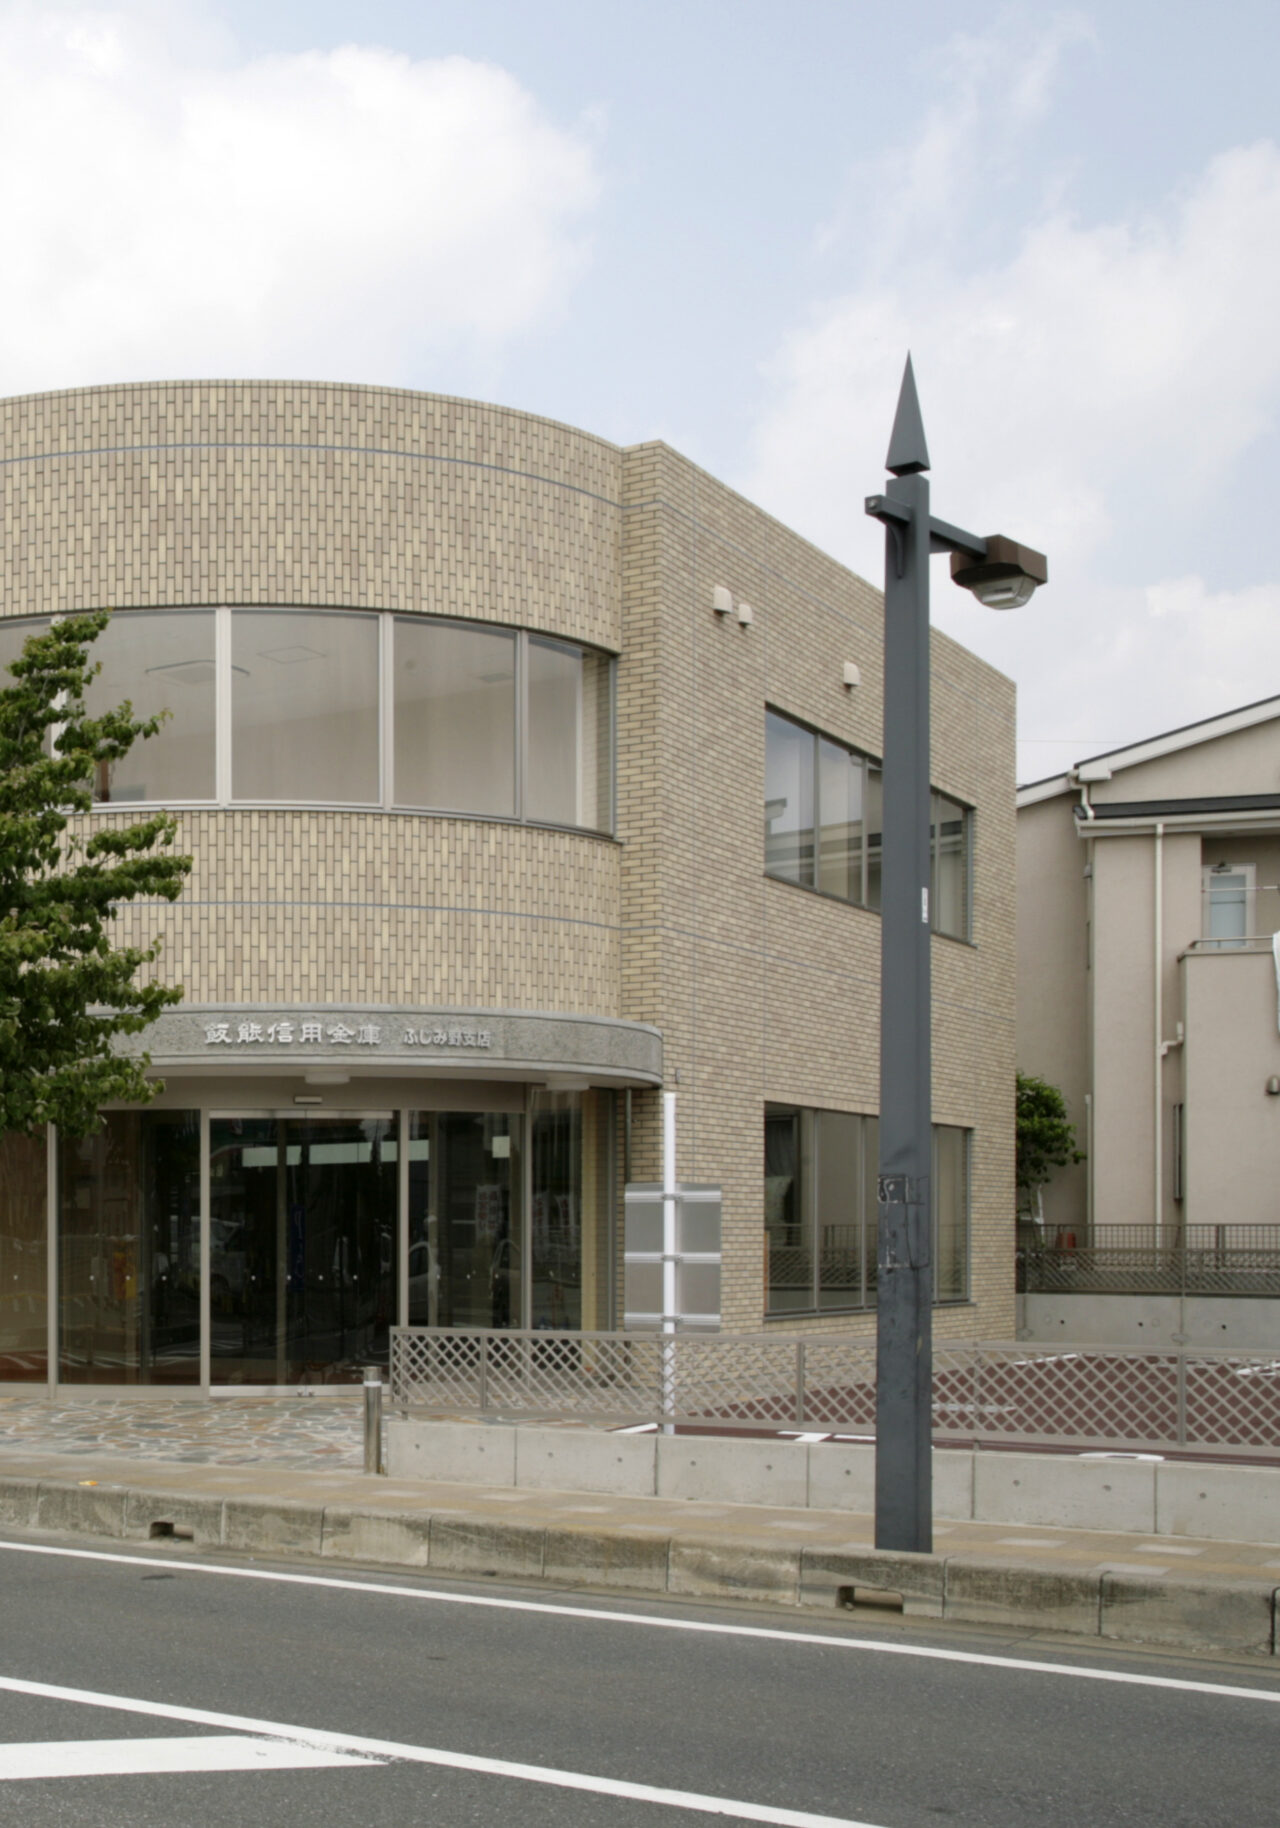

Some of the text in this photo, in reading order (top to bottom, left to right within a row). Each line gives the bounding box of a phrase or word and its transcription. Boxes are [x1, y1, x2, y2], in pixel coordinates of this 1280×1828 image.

[204, 1022, 492, 1048] 飯能信用金庫 ふじみ野支店
